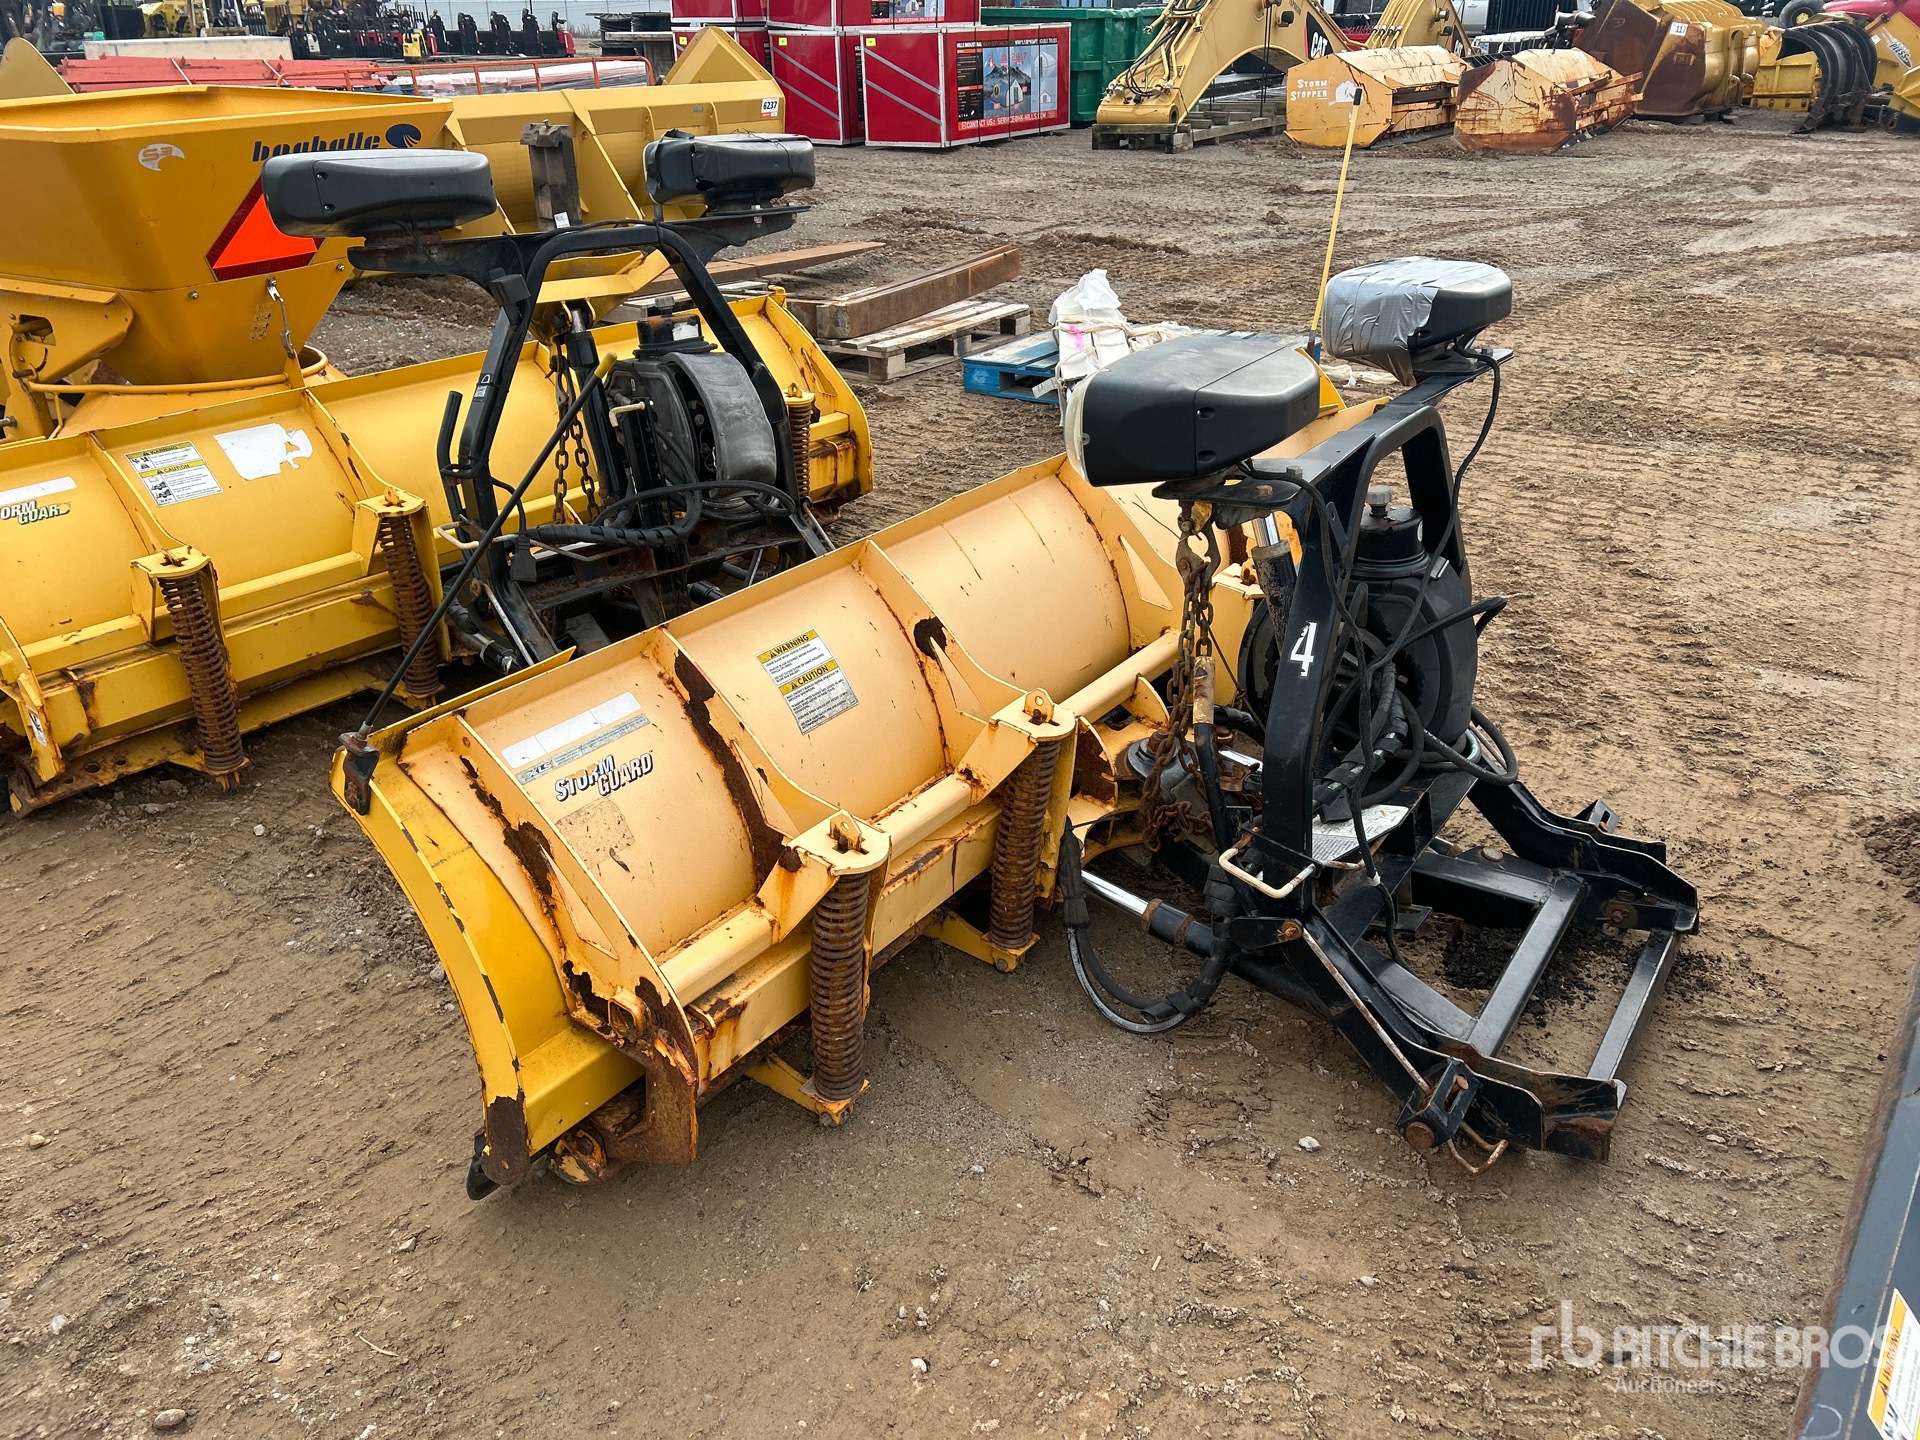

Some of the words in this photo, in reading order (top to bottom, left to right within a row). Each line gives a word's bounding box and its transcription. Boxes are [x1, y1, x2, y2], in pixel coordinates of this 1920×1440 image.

[1311, 31, 1328, 58] CAT
[1297, 79, 1328, 88] STORM
[763, 101, 777, 110] 6237
[1290, 90, 1328, 101] STOPPER
[163, 464, 190, 473] CAUTION
[0, 500, 36, 520] ORM
[774, 634, 809, 655] WARNING
[1290, 621, 1317, 677] 4
[797, 664, 829, 685] CAUTION
[598, 753, 653, 797] GUARD
